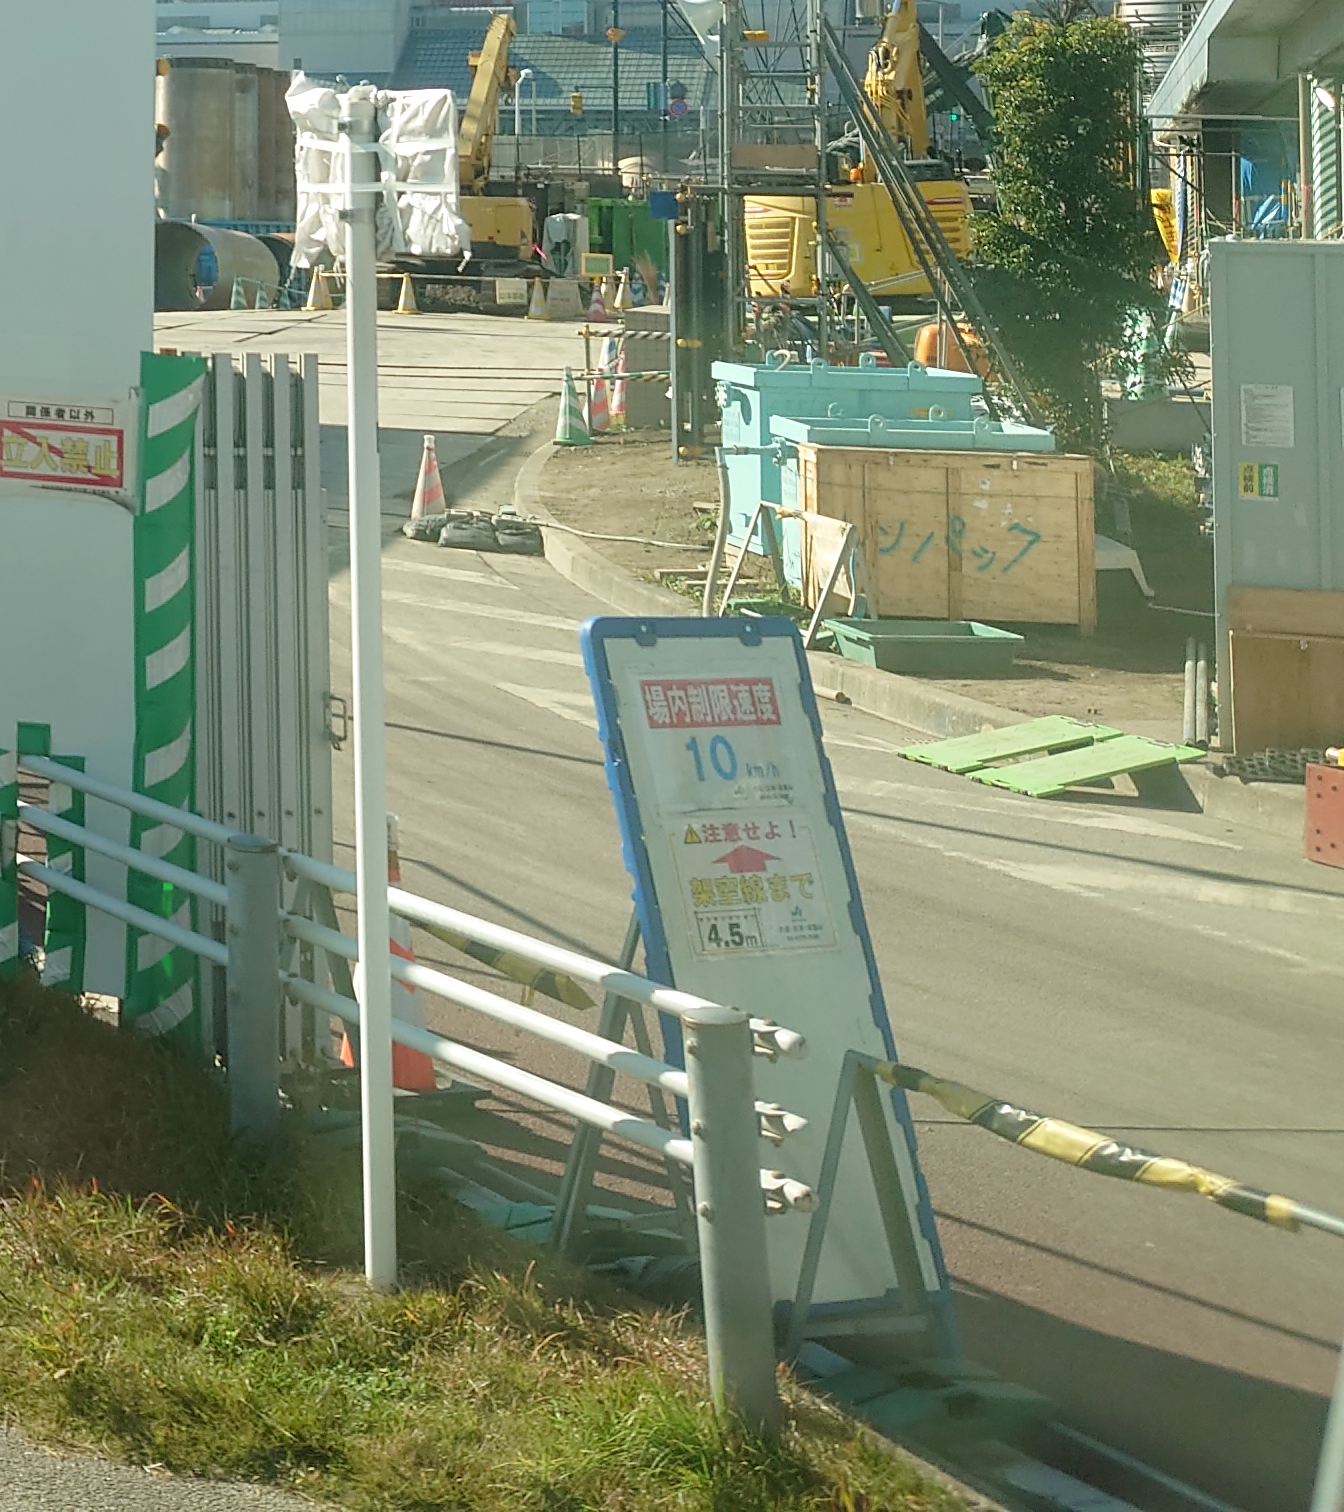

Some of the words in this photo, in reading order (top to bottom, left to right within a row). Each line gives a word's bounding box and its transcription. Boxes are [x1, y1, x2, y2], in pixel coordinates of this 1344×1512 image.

[25, 405, 95, 421] 関係者以外
[0, 435, 120, 477] 立入禁止
[645, 682, 776, 725] 場内制限速度
[685, 734, 738, 782] 10
[745, 762, 780, 778] km/h
[690, 872, 814, 908] 架空線まで
